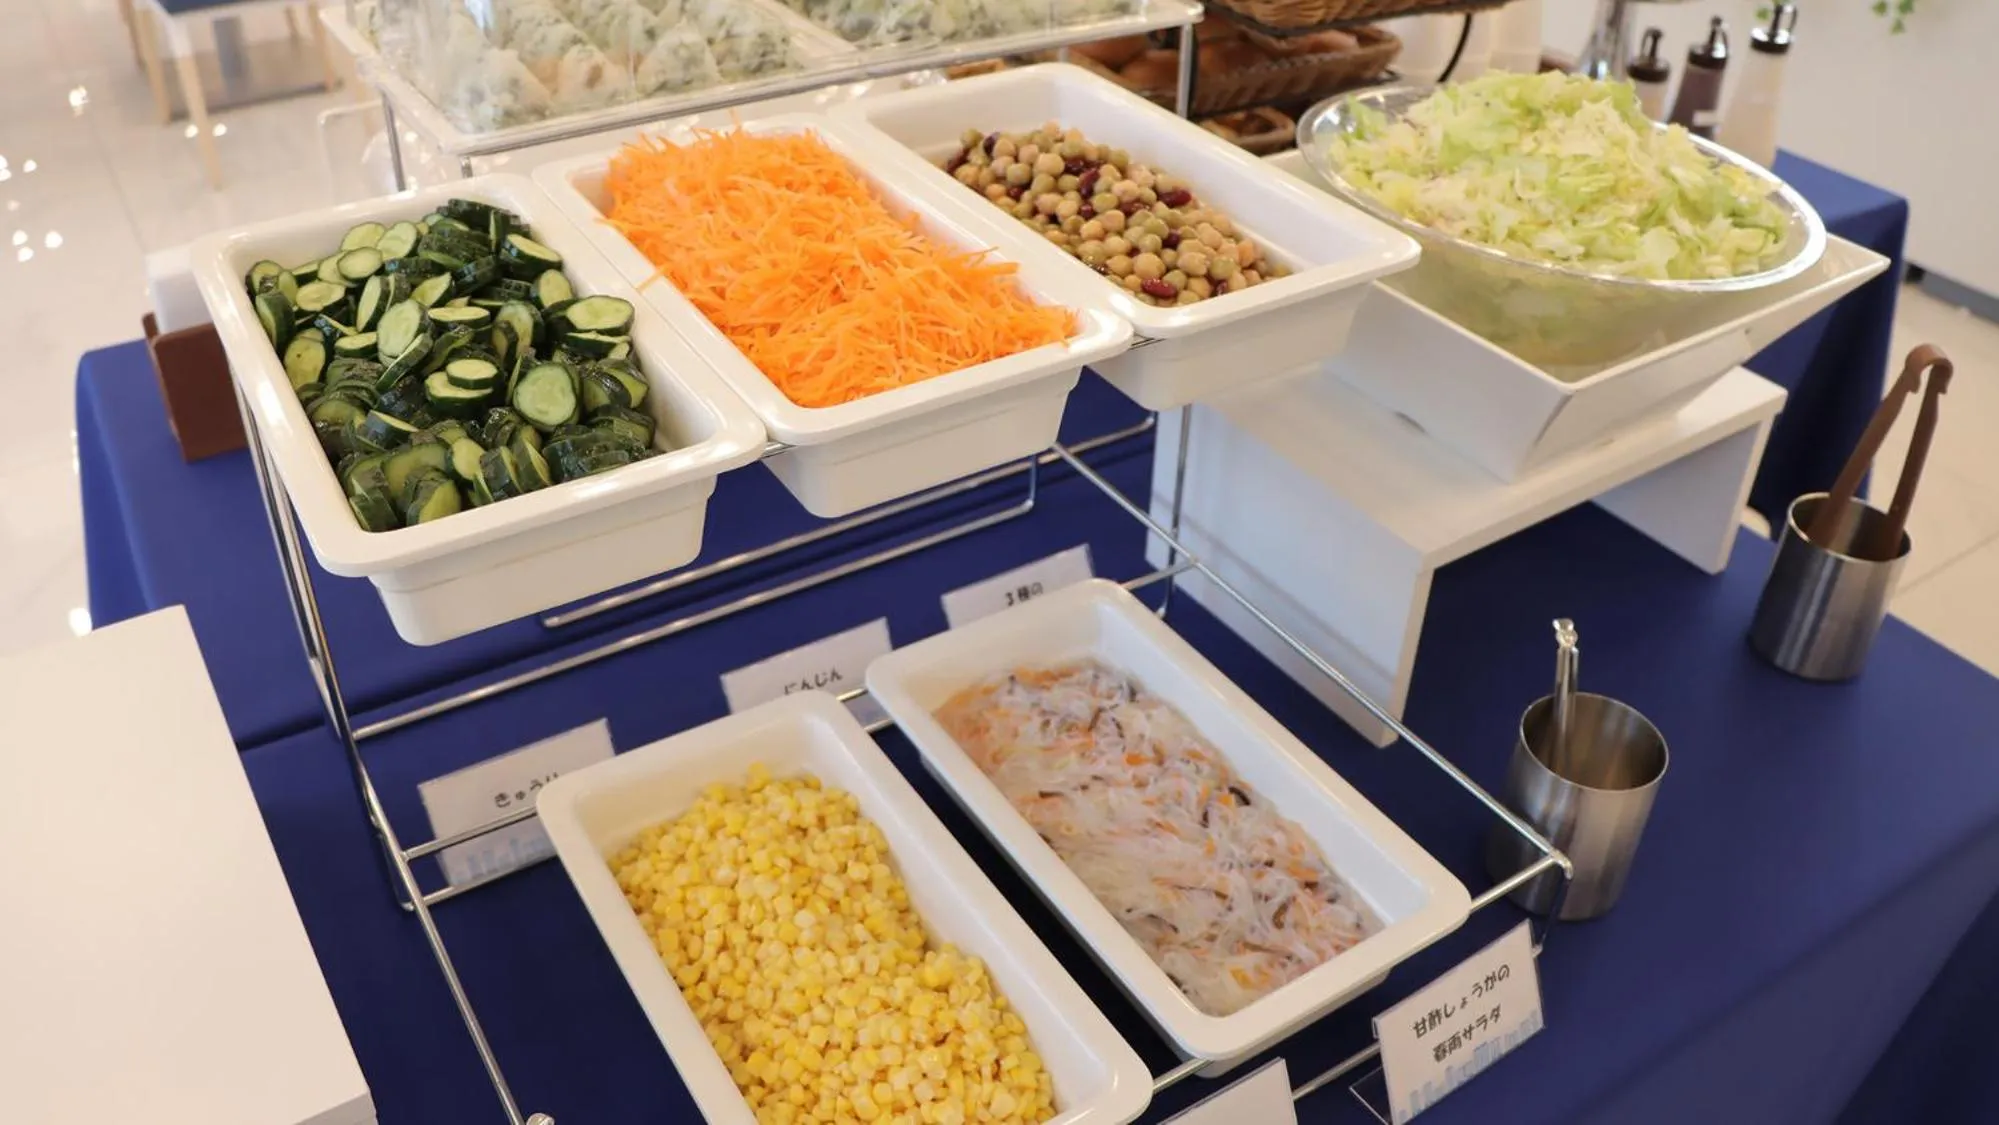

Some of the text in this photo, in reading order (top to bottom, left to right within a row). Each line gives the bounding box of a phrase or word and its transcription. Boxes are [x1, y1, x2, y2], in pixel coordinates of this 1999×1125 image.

[1412, 963, 1511, 1039] 甘酢しょうがの
[1432, 1003, 1502, 1063] 春雨サラダ
